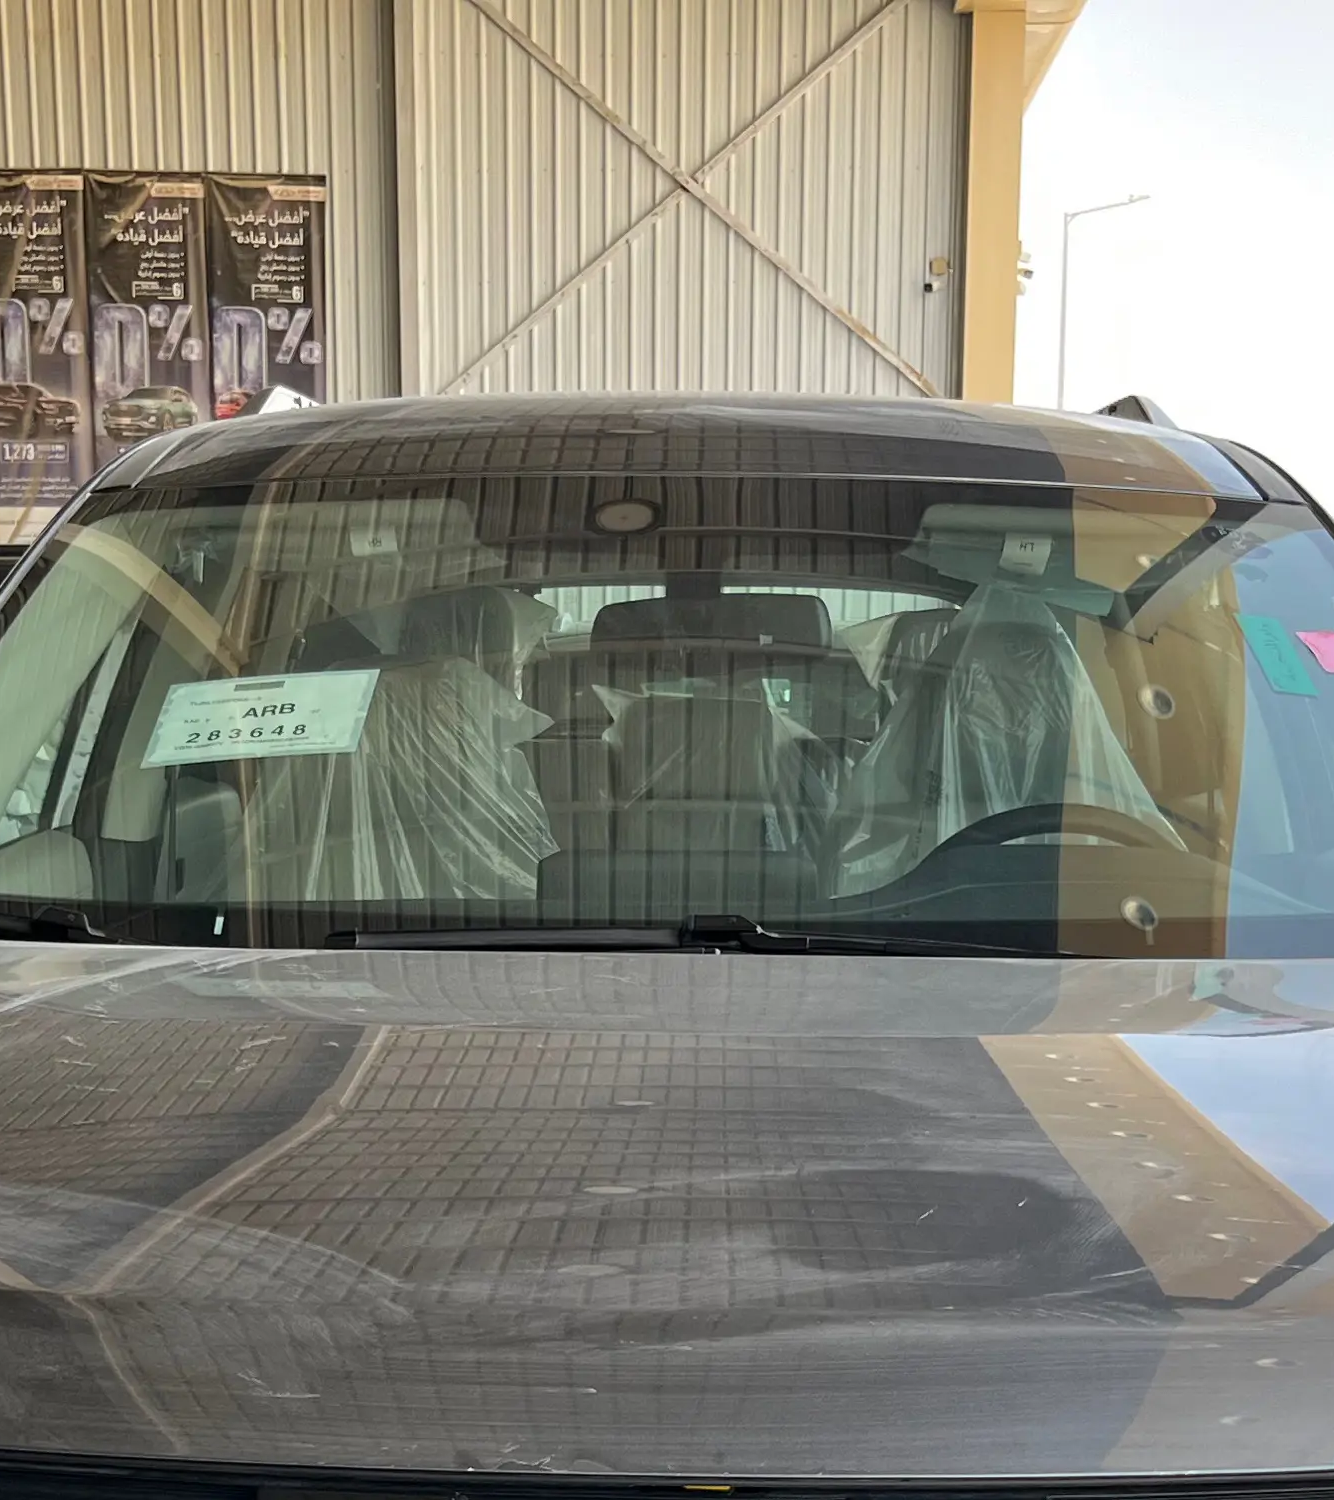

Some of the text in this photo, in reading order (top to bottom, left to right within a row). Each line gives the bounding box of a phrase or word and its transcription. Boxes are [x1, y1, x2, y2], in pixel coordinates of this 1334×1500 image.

[27, 217, 62, 239] أفضل
[148, 225, 183, 246] أفضل
[268, 228, 304, 248] أفضل
[291, 285, 301, 300] 6
[94, 302, 204, 392] 0%
[214, 305, 323, 396] 0%
[242, 703, 297, 719] ARB
[185, 724, 308, 744] 283648
